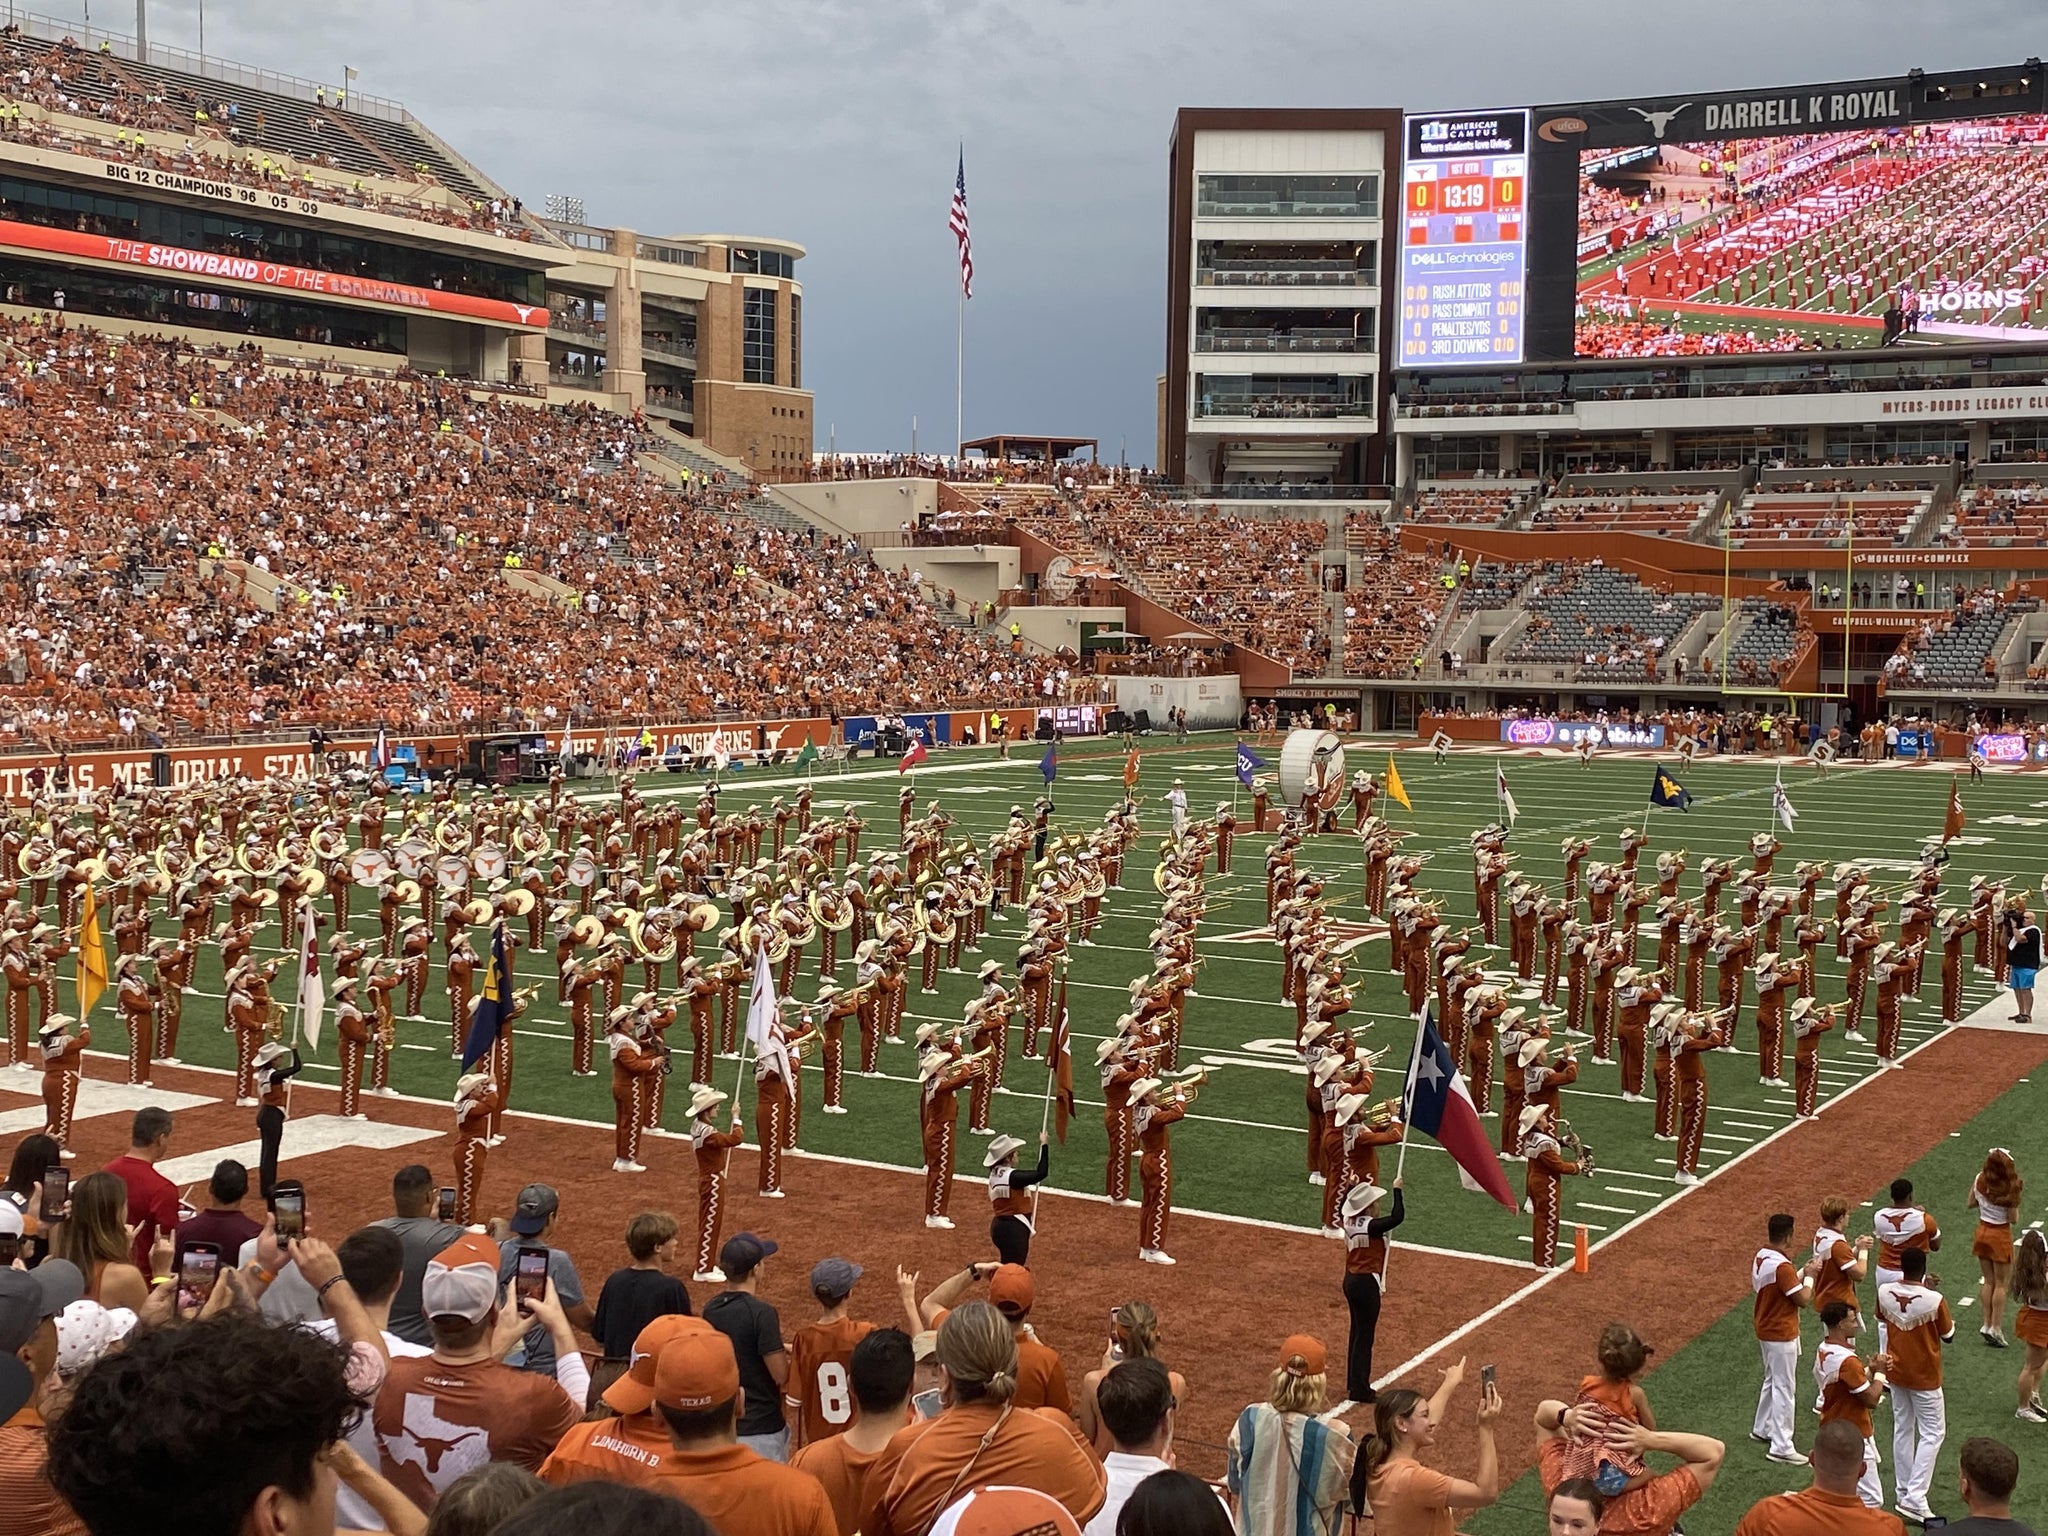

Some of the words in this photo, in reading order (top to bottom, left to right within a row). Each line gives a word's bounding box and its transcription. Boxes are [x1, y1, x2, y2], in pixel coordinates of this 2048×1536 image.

[1705, 98, 1801, 131] DARRELL
[1809, 96, 1824, 123] K
[1831, 90, 1900, 121] ROYAL
[1450, 120, 1498, 131] AMERICAN
[1558, 120, 1580, 131] ufcu
[1450, 129, 1498, 139] CAMPUS
[1444, 140, 1475, 152] students
[1475, 139, 1490, 150] love
[106, 164, 130, 180] BIG
[135, 170, 150, 183] 12
[155, 173, 232, 198] CHAMPIONS
[1416, 185, 1427, 207] 0
[1444, 183, 1484, 208] 13:19
[1502, 180, 1513, 203] 0
[107, 239, 142, 263] THE
[147, 247, 259, 280] SHOWBAND
[263, 268, 288, 284] OF
[294, 269, 325, 291] THE
[1411, 253, 1444, 265] DELL
[1445, 251, 1514, 265] Technologies
[1432, 284, 1456, 299] RUSH
[1457, 283, 1491, 299] ATT/TDS
[1918, 288, 2023, 312] HORNS
[1432, 304, 1453, 318] PASS
[1432, 320, 1491, 337] PENALTIES/YDS
[1431, 340, 1451, 355] 3RD
[1453, 338, 1490, 353] DOWNS
[1882, 399, 1970, 413] MYERS-DODDS
[1976, 397, 2023, 410] LEGACY
[1852, 553, 1866, 564] TEX
[1924, 554, 1969, 563] COMPLEX
[1275, 688, 1308, 697] SMOKEY
[1309, 689, 1326, 698] THE
[1327, 689, 1360, 698] CANNON
[1434, 735, 1448, 750] E
[1559, 728, 1570, 741] a
[1901, 737, 1930, 746] DEL
[663, 730, 752, 756] LONGHRNS
[1577, 737, 1594, 756] X
[1679, 741, 1693, 757] A
[1984, 737, 2021, 749] Jersey
[1814, 746, 1828, 760] S
[680, 1395, 712, 1407] TEXAS
[817, 1362, 851, 1424] 8
